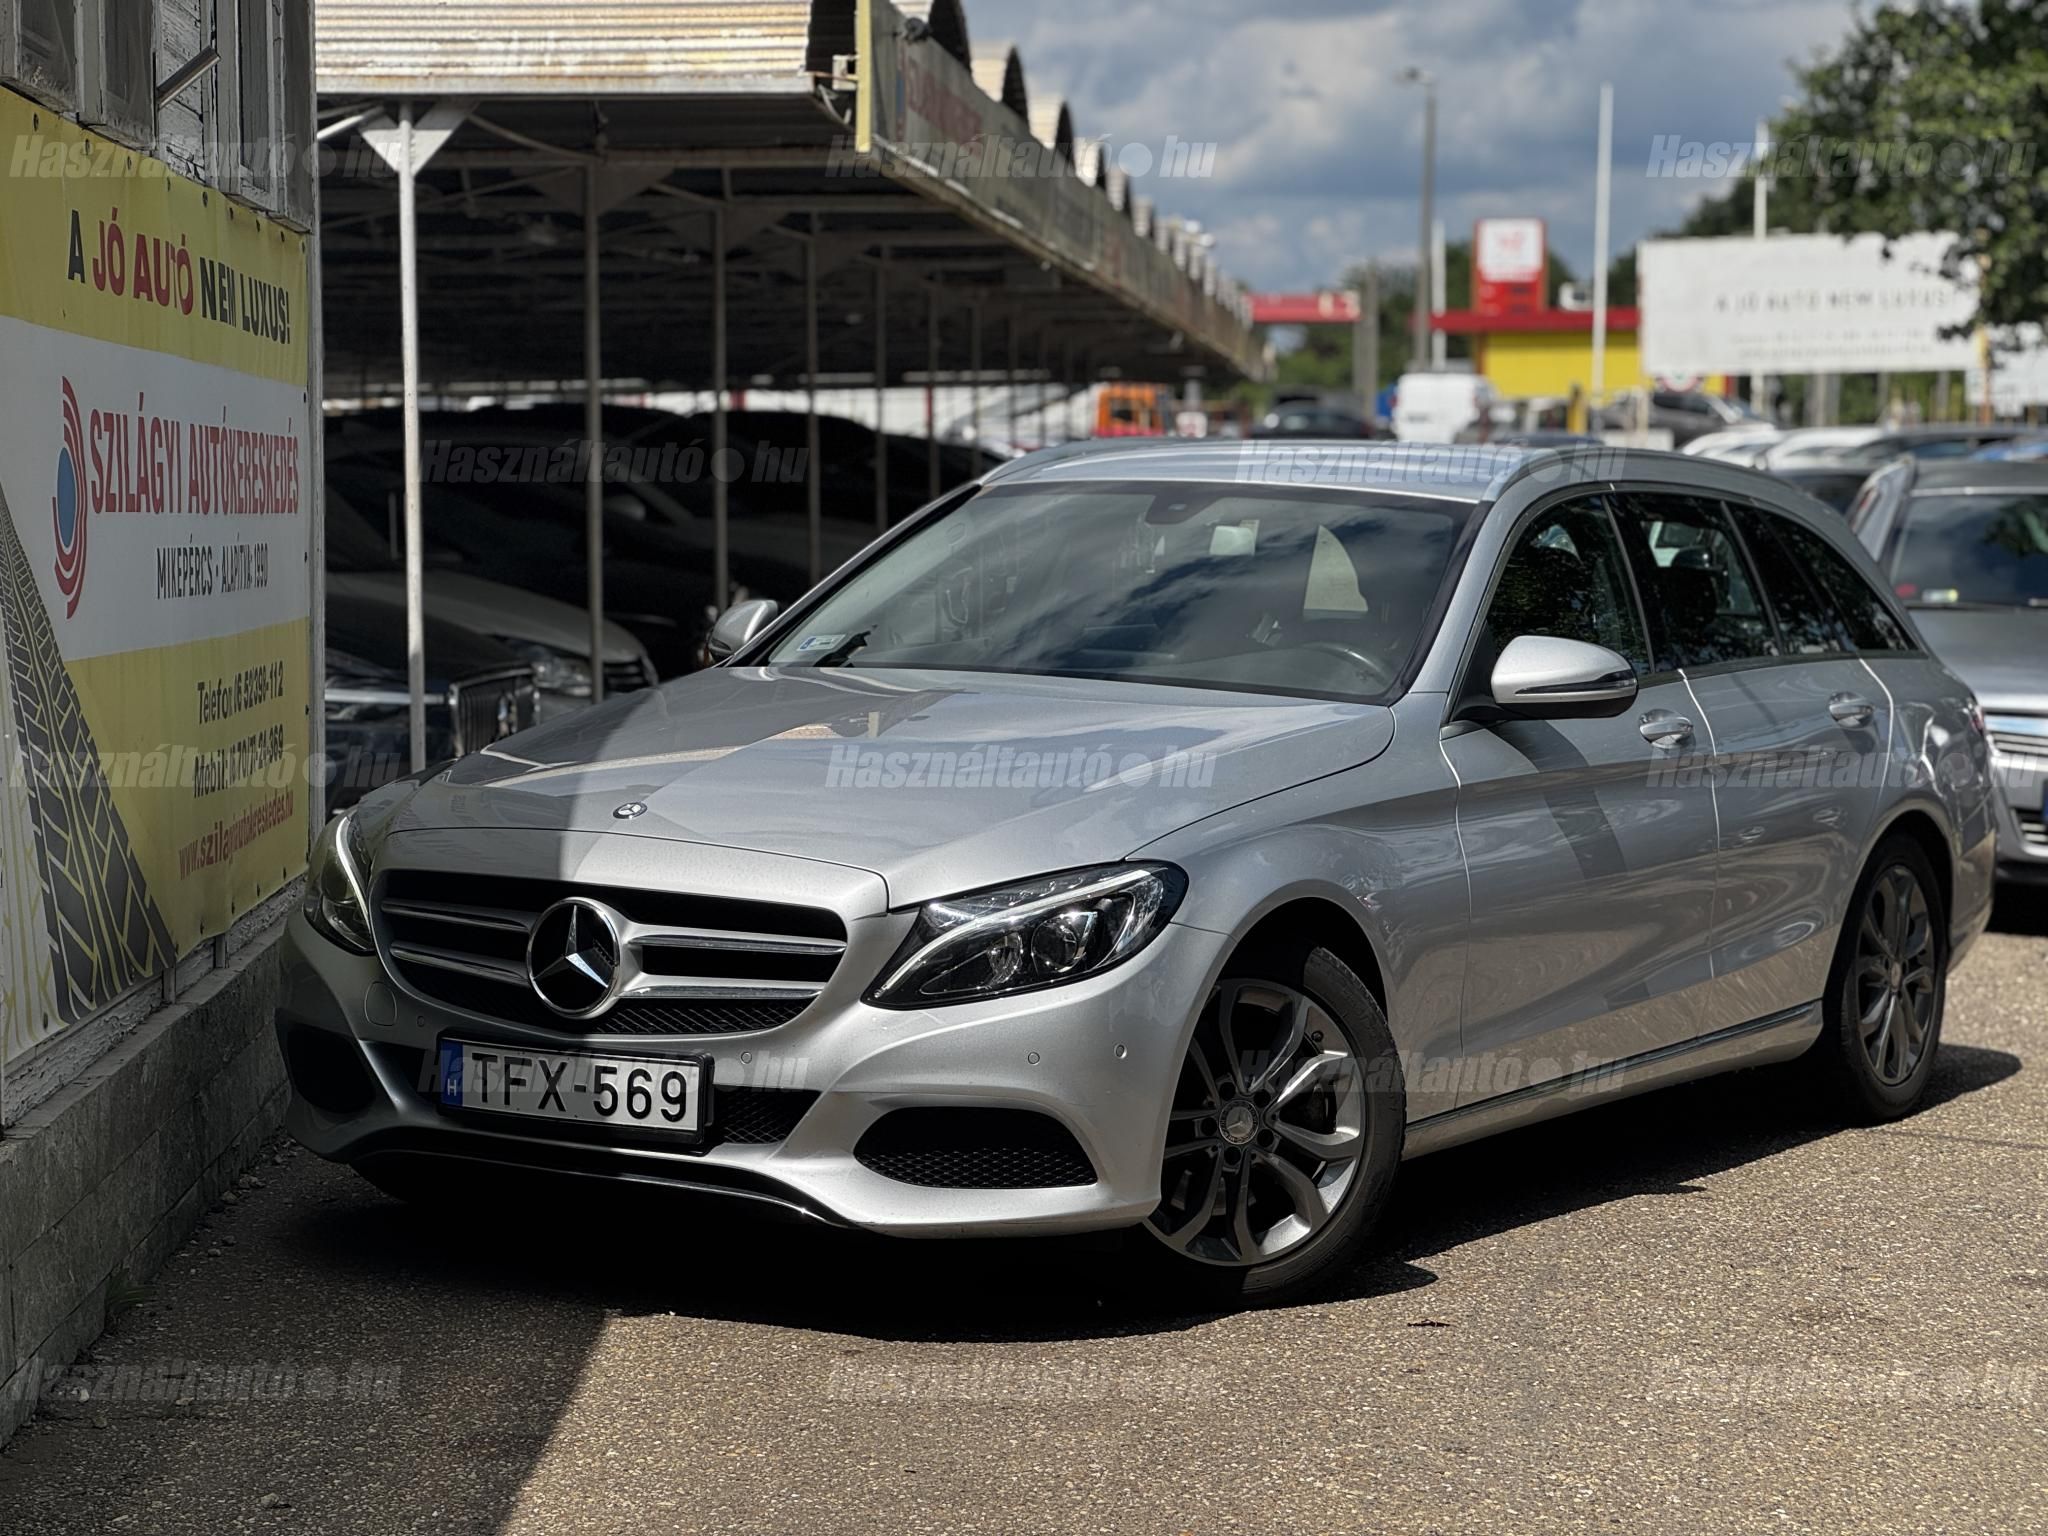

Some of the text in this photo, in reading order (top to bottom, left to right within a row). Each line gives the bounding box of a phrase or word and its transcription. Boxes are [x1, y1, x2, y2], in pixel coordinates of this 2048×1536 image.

[68, 206, 290, 345] A JÓ AUTÓ NEM LUXUS!
[90, 391, 299, 516] SZILÁGYI AUTÓKERESKEDÉS
[156, 533, 213, 600] MIKEPÉRCS
[447, 1052, 687, 1122] H TFX-569
